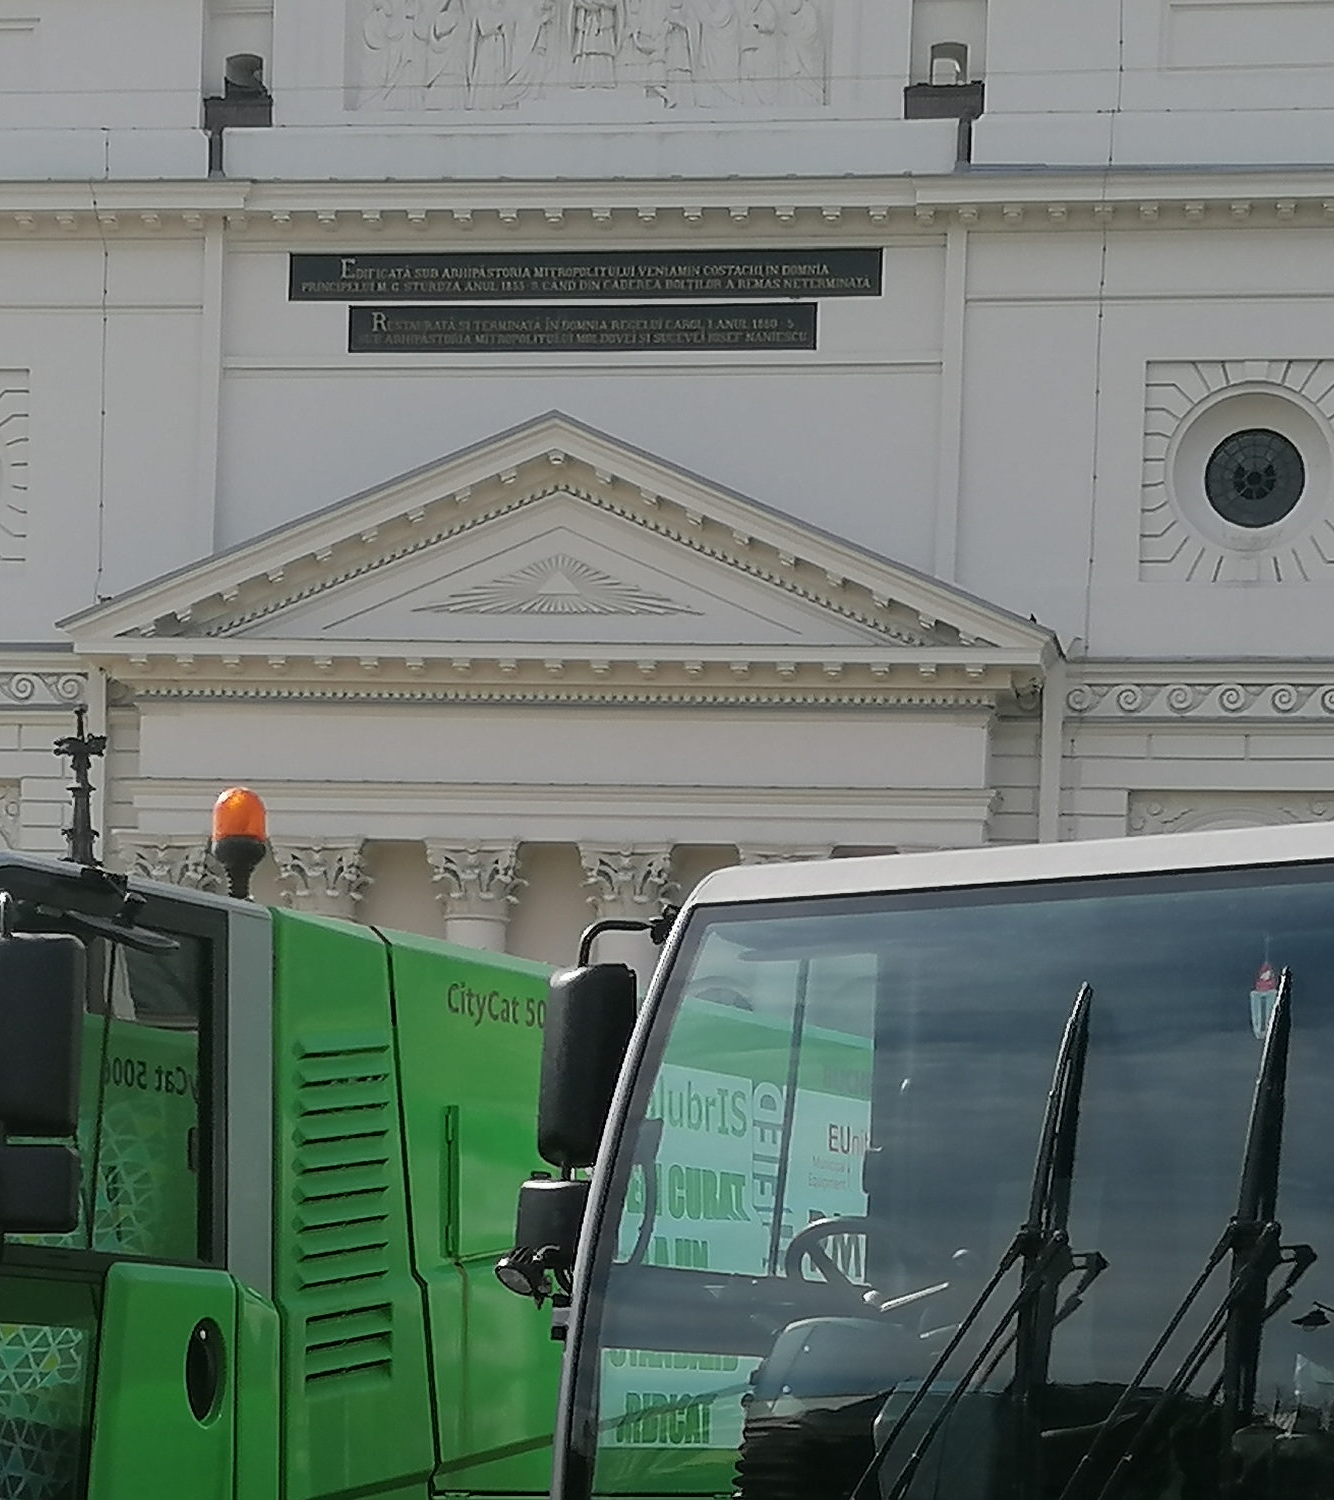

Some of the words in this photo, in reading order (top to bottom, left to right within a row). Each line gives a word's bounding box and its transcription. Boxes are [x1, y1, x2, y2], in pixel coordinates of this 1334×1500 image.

[414, 267, 439, 279] SUB
[533, 265, 635, 278] MITROPOLITULUI
[637, 264, 700, 278] VENIAMIN
[404, 281, 461, 292] STURDZA
[465, 281, 496, 292] ANUL
[579, 279, 600, 291] DIN
[726, 279, 735, 289] A
[561, 319, 607, 331] DOMNIA
[716, 319, 748, 329] ANUL
[475, 332, 573, 344] MITROPOLITULUI
[447, 982, 520, 1027] CityCat
[668, 1164, 751, 1222] CURAT
[616, 1391, 719, 1444] RIDICAT
